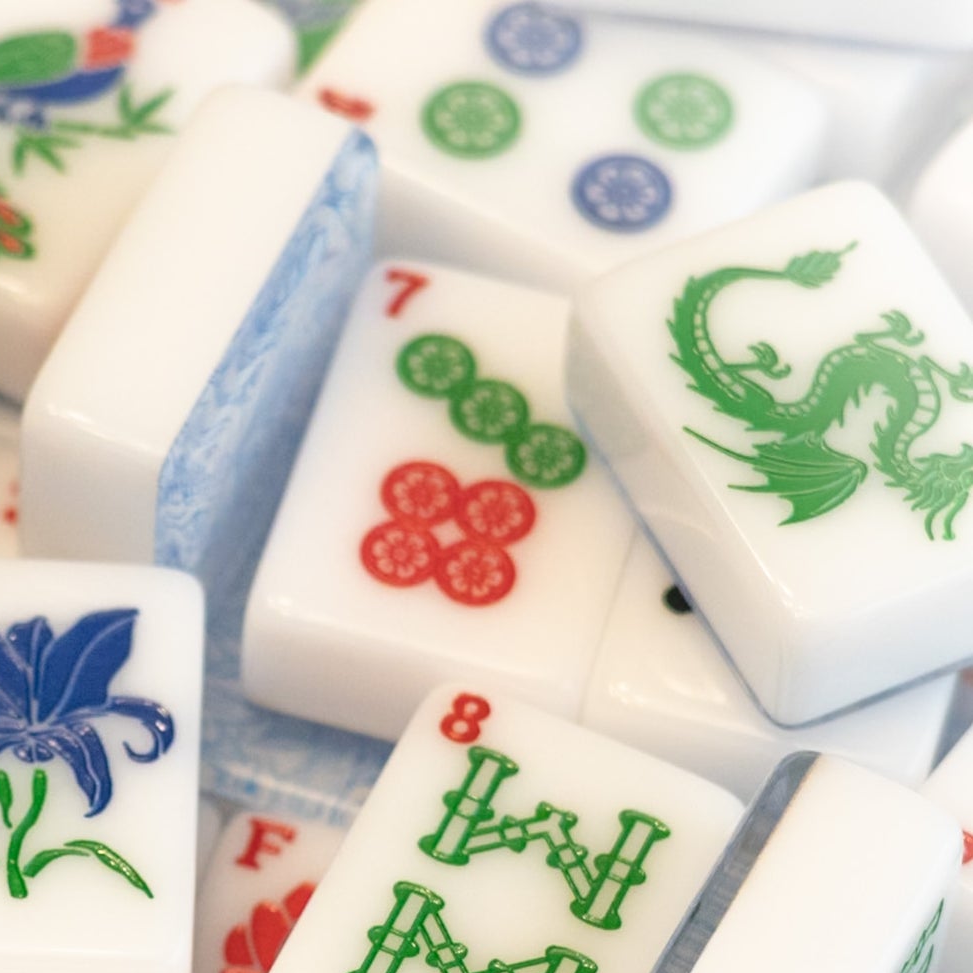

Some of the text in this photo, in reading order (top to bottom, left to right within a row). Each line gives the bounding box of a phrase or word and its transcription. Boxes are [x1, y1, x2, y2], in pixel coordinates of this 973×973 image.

[386, 268, 430, 318] 7
[438, 690, 493, 746] 8
[234, 816, 299, 872] F
